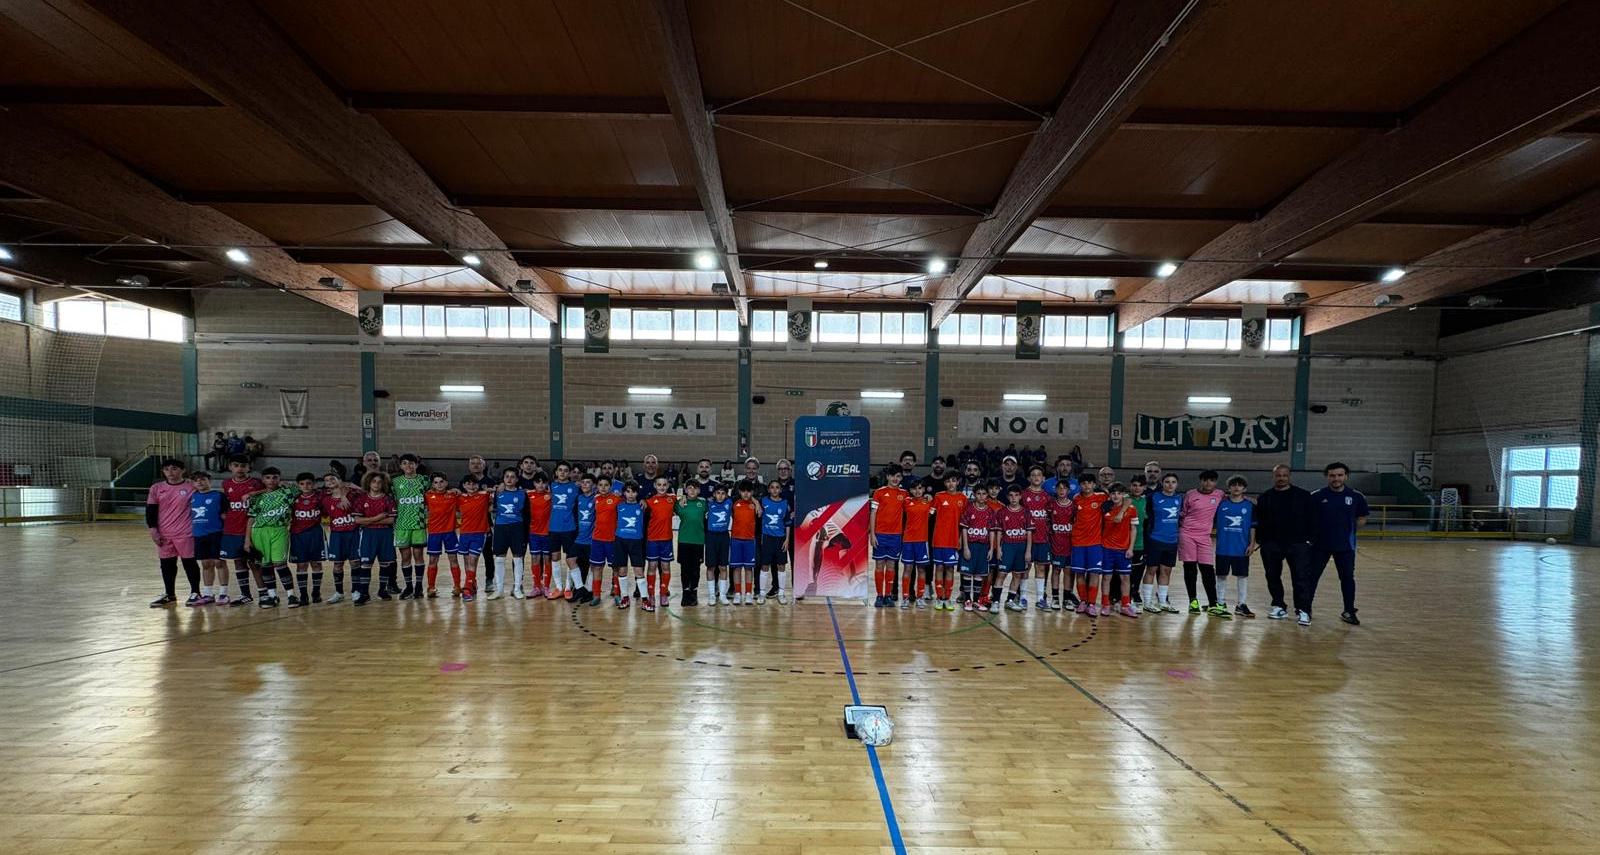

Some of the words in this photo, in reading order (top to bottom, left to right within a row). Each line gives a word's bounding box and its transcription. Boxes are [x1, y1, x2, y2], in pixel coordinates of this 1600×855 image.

[398, 409, 448, 418] GinevraRent
[594, 412, 706, 430] FUTSAL
[983, 417, 1064, 434] NOCI
[294, 509, 320, 518] GOUP
